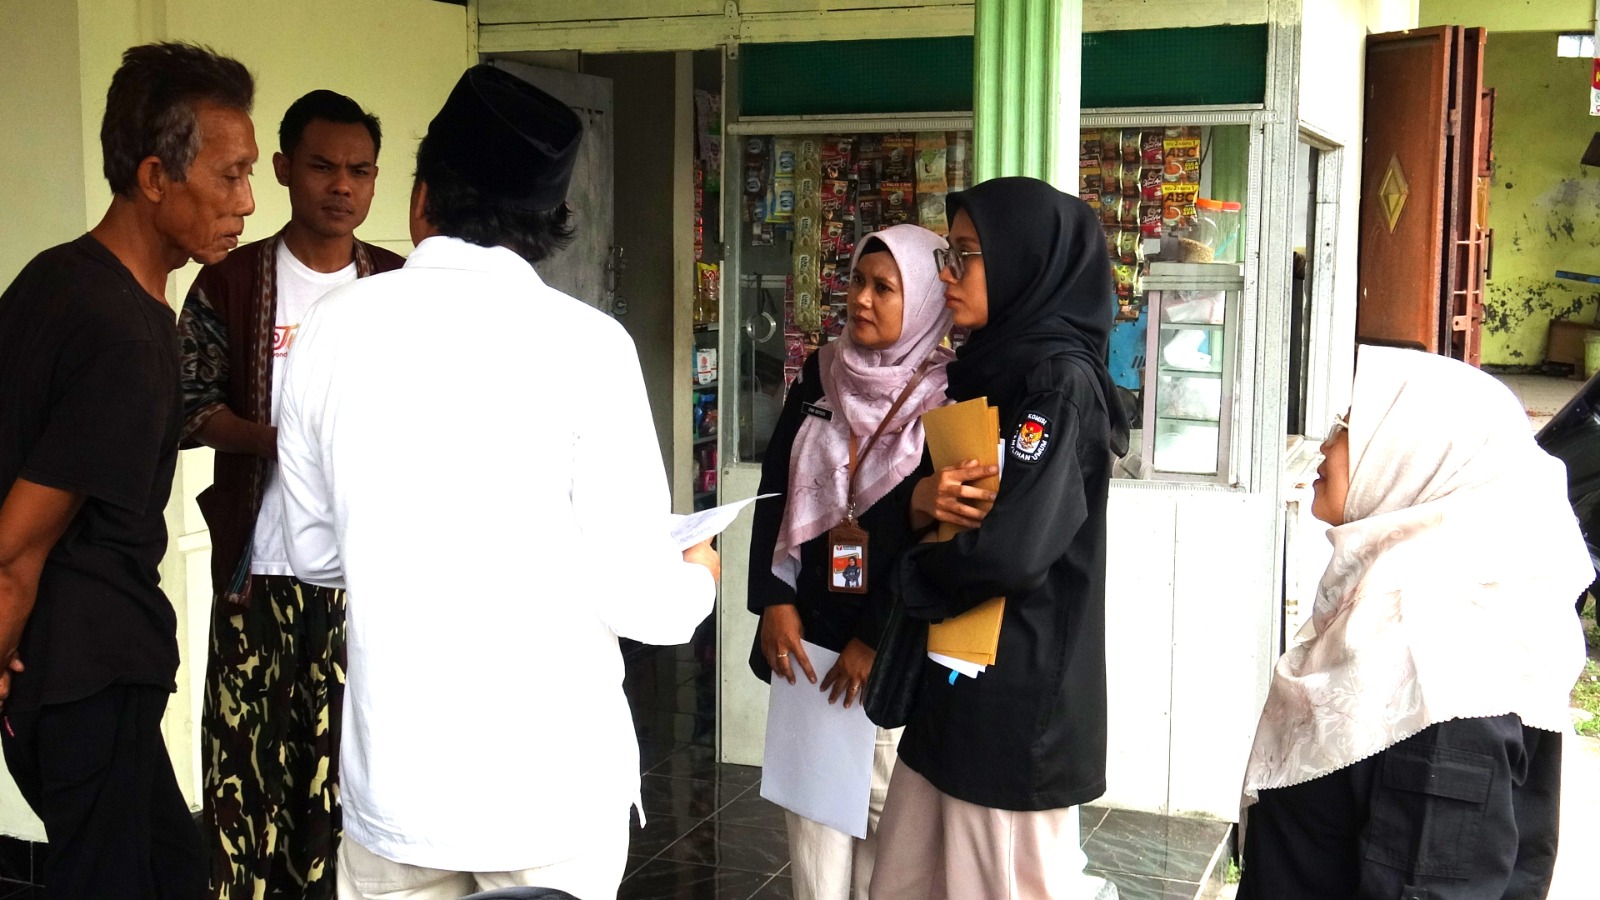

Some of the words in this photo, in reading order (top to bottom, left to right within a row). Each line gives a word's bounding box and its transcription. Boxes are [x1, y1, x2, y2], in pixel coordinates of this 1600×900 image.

[1166, 147, 1196, 158] ABC
[1165, 192, 1195, 202] ABC
[1028, 413, 1047, 426] KOMISI
[1032, 440, 1048, 461] UMUM
